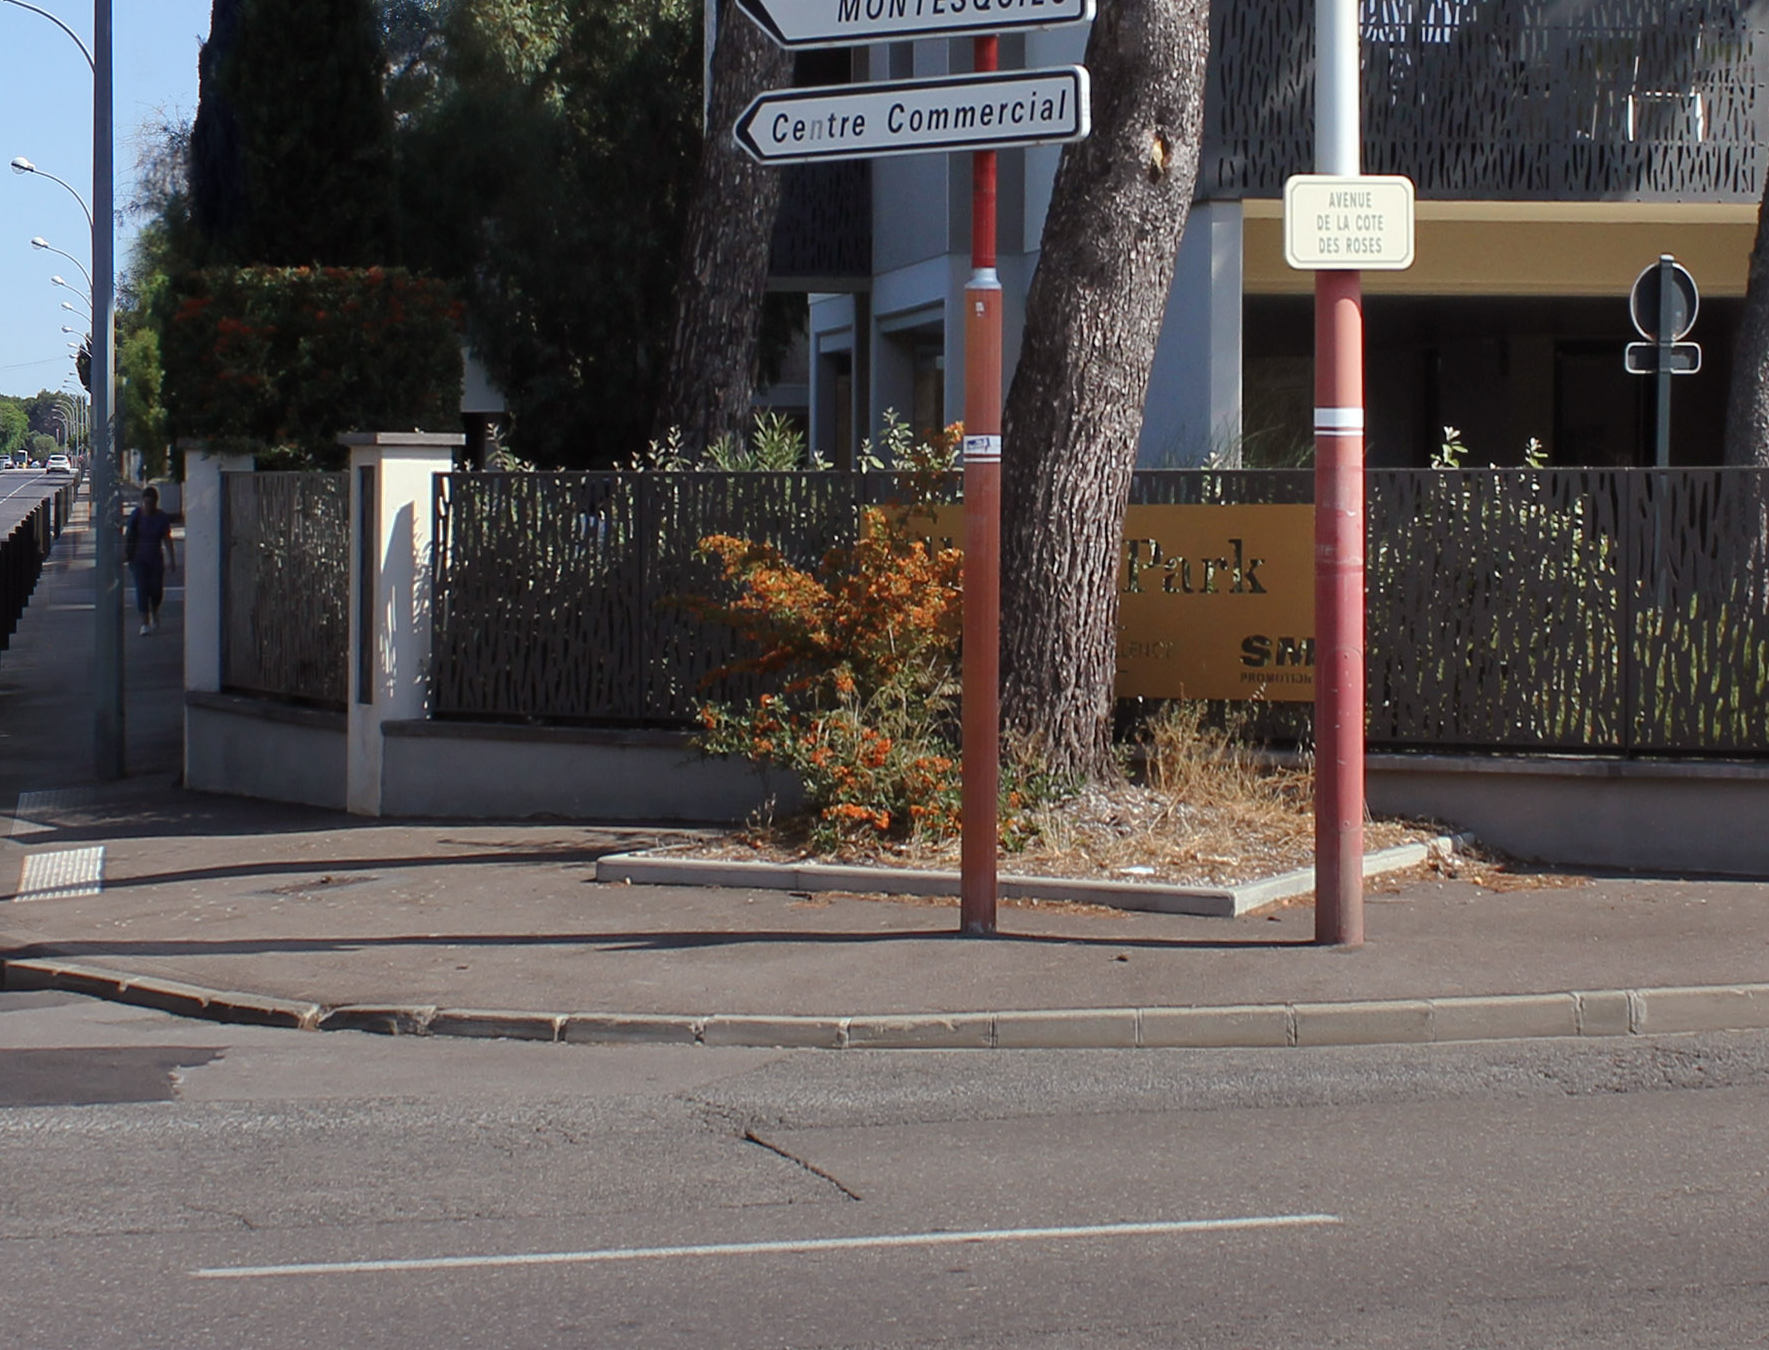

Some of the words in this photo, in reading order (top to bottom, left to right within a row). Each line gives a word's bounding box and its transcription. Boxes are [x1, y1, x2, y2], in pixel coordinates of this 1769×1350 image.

[772, 112, 866, 143] Centre
[888, 89, 1067, 134] Commercial
[1329, 191, 1372, 208] AVENUE
[1317, 214, 1330, 231] DE
[1337, 214, 1350, 231] LA
[1355, 214, 1384, 231] COTE
[1319, 237, 1340, 254] DES
[1346, 237, 1382, 254] ROSES
[1122, 538, 1268, 594] Park
[1240, 672, 1312, 684] PROMOTION
